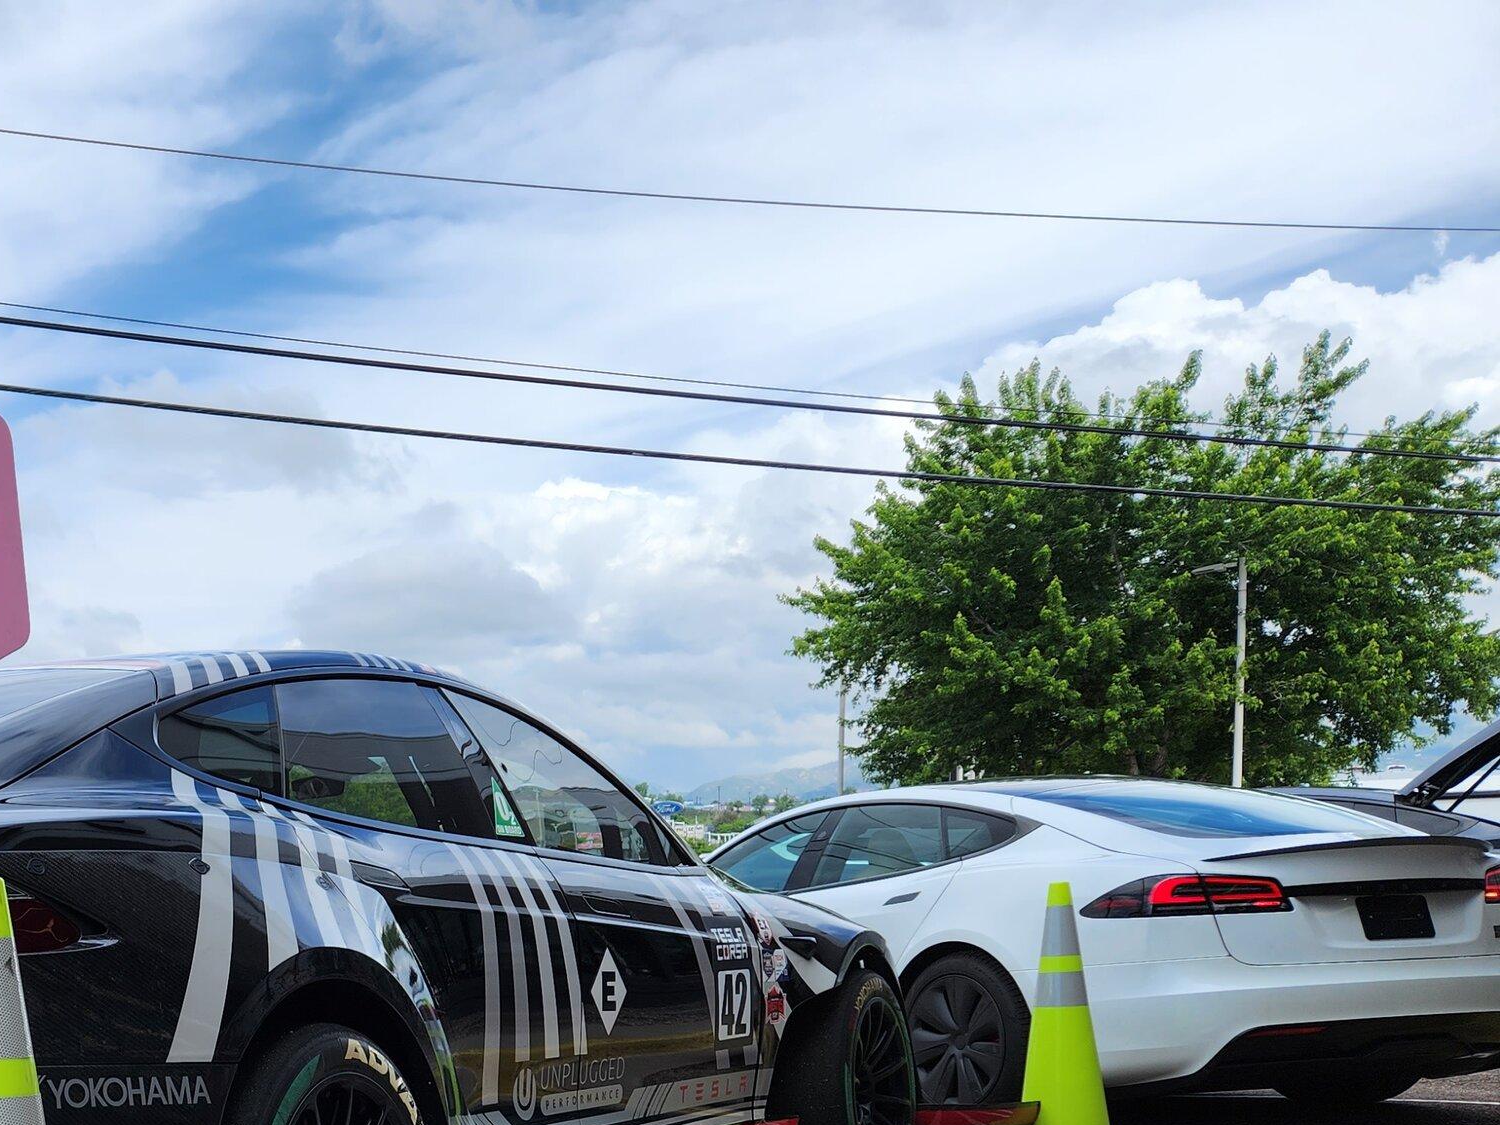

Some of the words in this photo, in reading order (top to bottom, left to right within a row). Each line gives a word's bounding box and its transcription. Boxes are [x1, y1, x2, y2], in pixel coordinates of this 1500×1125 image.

[710, 927, 745, 943] TESLA
[716, 943, 749, 960] CORSA
[602, 971, 617, 1011] E
[721, 972, 748, 1036] 42
[540, 1056, 626, 1091] UNPLUGGED
[679, 1074, 748, 1104] TESLA
[46, 1075, 212, 1110] YOKOHAMA
[545, 1087, 620, 1110] PERFORMANCE
